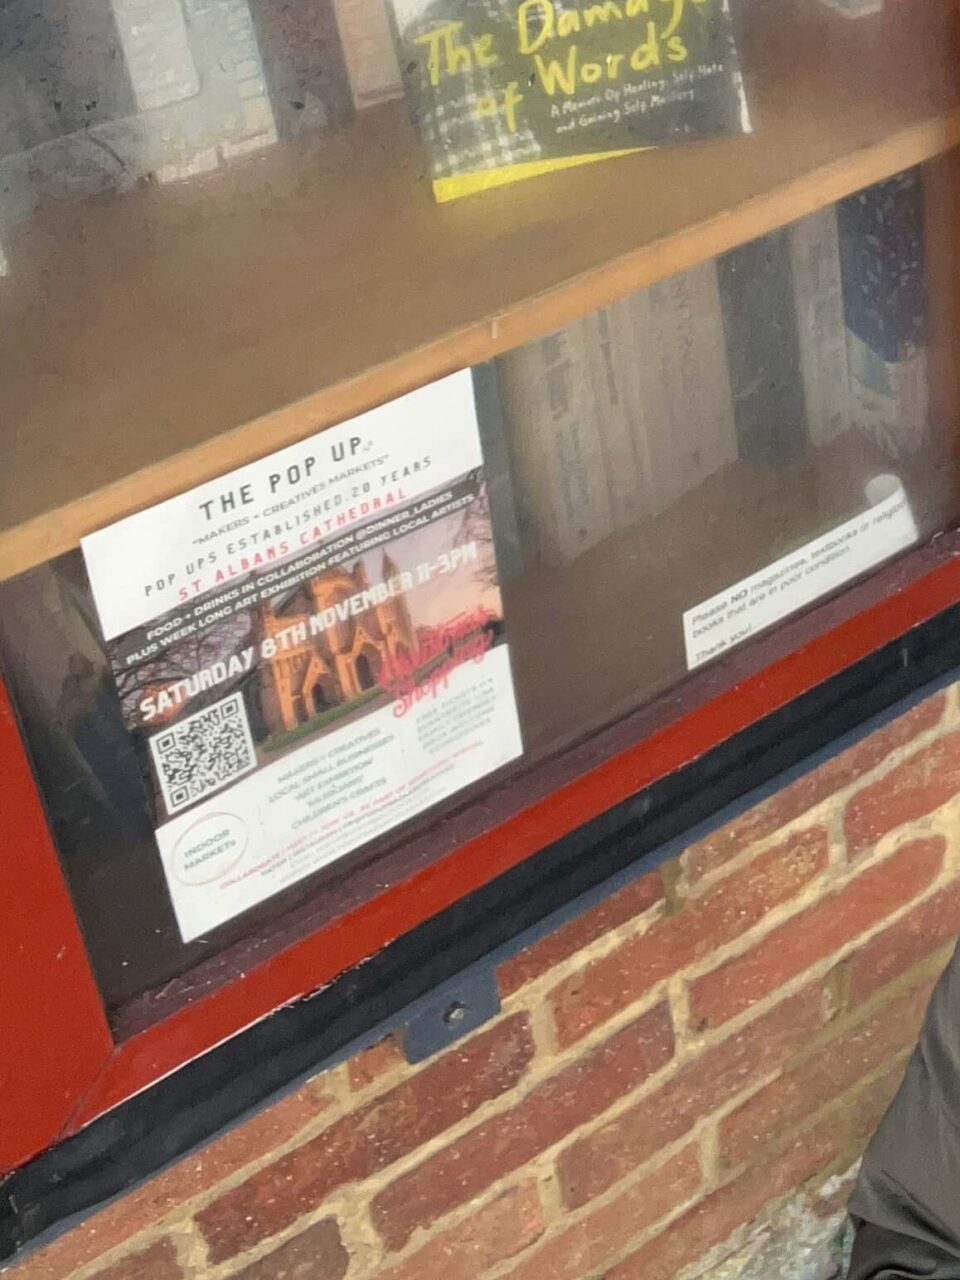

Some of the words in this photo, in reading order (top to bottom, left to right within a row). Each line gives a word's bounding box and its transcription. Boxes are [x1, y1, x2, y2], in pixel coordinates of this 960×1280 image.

[413, 21, 498, 86] The
[475, 81, 524, 133] of
[535, 21, 688, 96] Words
[551, 104, 560, 119] A
[198, 483, 254, 523] THE
[268, 455, 317, 493] POP
[330, 433, 363, 464] UP
[262, 480, 326, 518] CREATIVES
[144, 572, 177, 597] POP
[185, 550, 217, 576] UPS
[380, 455, 431, 487] YEARS
[178, 578, 203, 601] ST
[213, 538, 289, 585] ALBANS
[298, 484, 407, 545] CATHEDRAL
[125, 641, 158, 665] PLUS
[159, 622, 196, 647] WEEK
[197, 604, 232, 628] LONG
[233, 592, 258, 612] ART
[259, 560, 326, 599] EXHIBITION
[328, 529, 392, 567] FEATURING
[392, 512, 429, 537] LOCAL
[430, 491, 474, 519] ARTISTS
[145, 615, 183, 641] FOOD
[193, 588, 240, 617] DRINKS
[241, 581, 254, 594] IN
[256, 534, 353, 588] COLLABORATION
[727, 602, 746, 619] that
[749, 593, 766, 607] are
[730, 588, 748, 604] NO
[138, 647, 257, 723] SATURDAY
[259, 620, 307, 661] 8TH
[308, 568, 413, 638] NOVEMBER
[415, 538, 477, 587] 11-3PM
[696, 639, 728, 661] Thank
[183, 827, 231, 859] INDOOR
